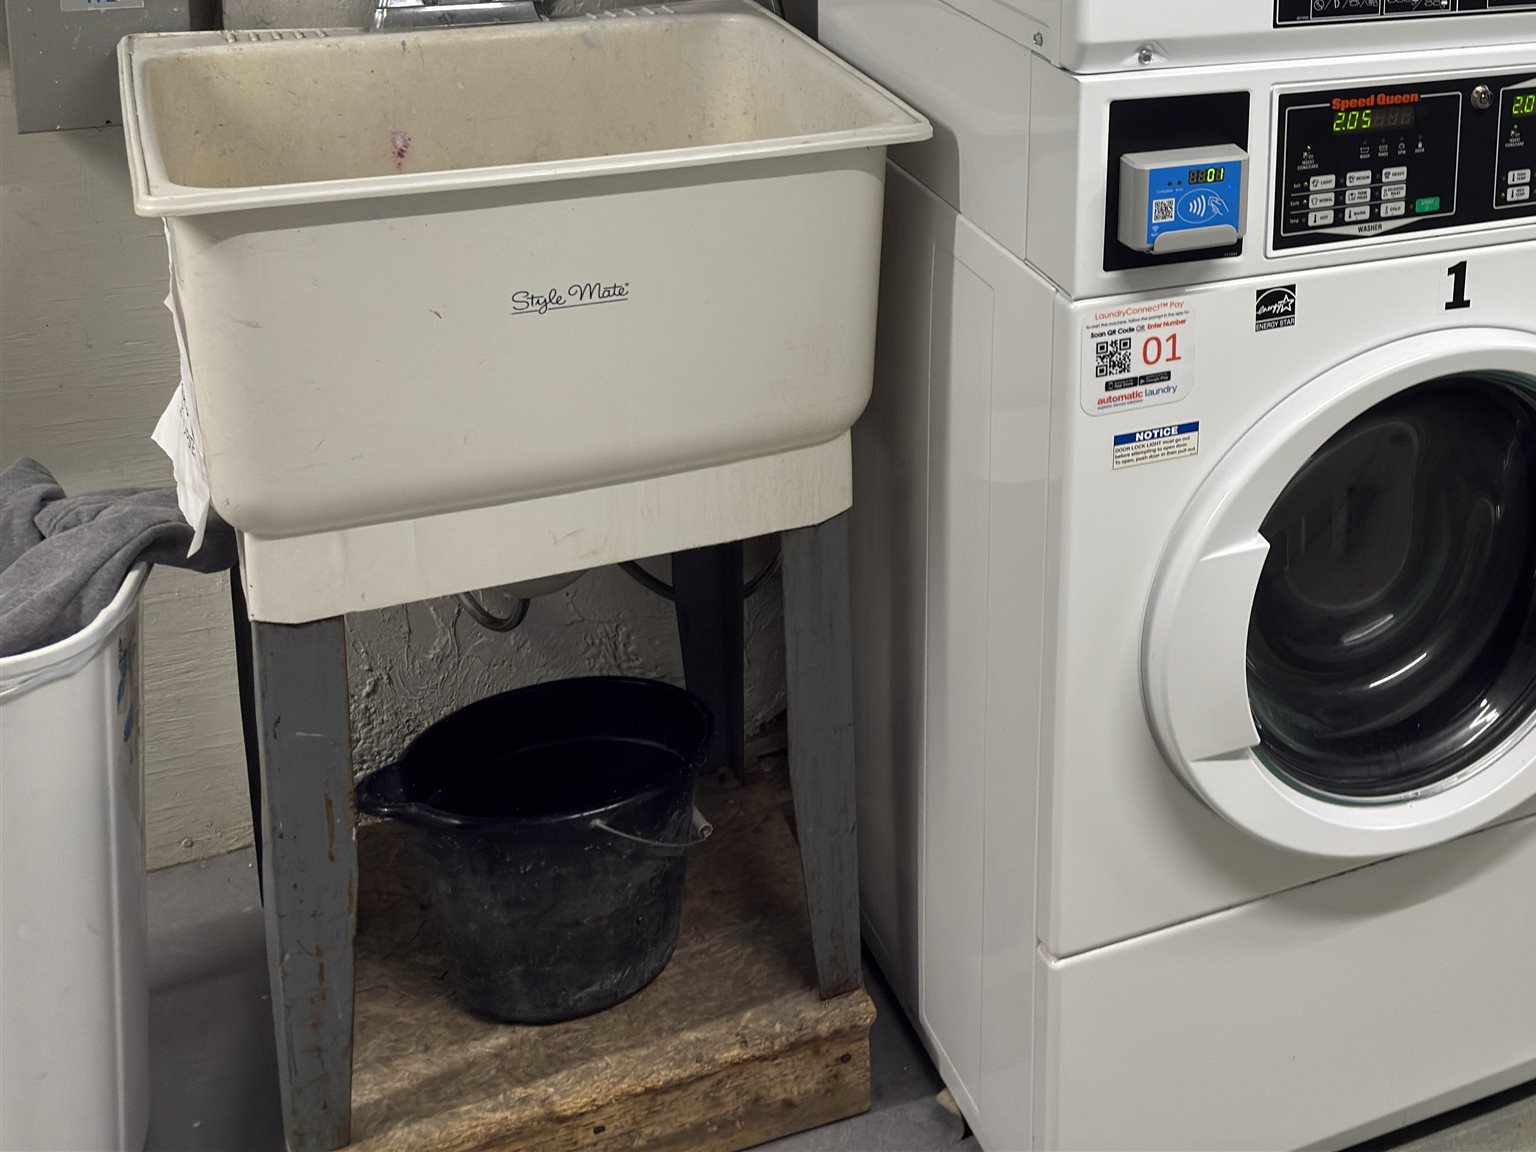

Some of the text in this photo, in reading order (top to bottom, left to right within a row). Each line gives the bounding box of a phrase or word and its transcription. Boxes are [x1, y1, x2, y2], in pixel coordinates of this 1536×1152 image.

[1332, 93, 1419, 111] Speed Queen
[1333, 110, 1372, 132] 2.05
[1207, 168, 1224, 182] 01
[1358, 224, 1382, 233] WASHER
[1445, 261, 1471, 310] 1
[512, 283, 629, 315] Style Mate
[1170, 301, 1184, 309] Pay
[1091, 330, 1106, 338] Scan
[1147, 322, 1162, 330] Enter
[1163, 319, 1186, 327] Number
[1256, 318, 1295, 331] ENERGY STAR
[1142, 333, 1182, 366] 01
[1098, 390, 1143, 405] automatic
[1145, 385, 1177, 397] laundry
[1136, 426, 1179, 442] NOTICE
[1115, 445, 1130, 453] DOOR
[1132, 443, 1146, 451] LOCK
